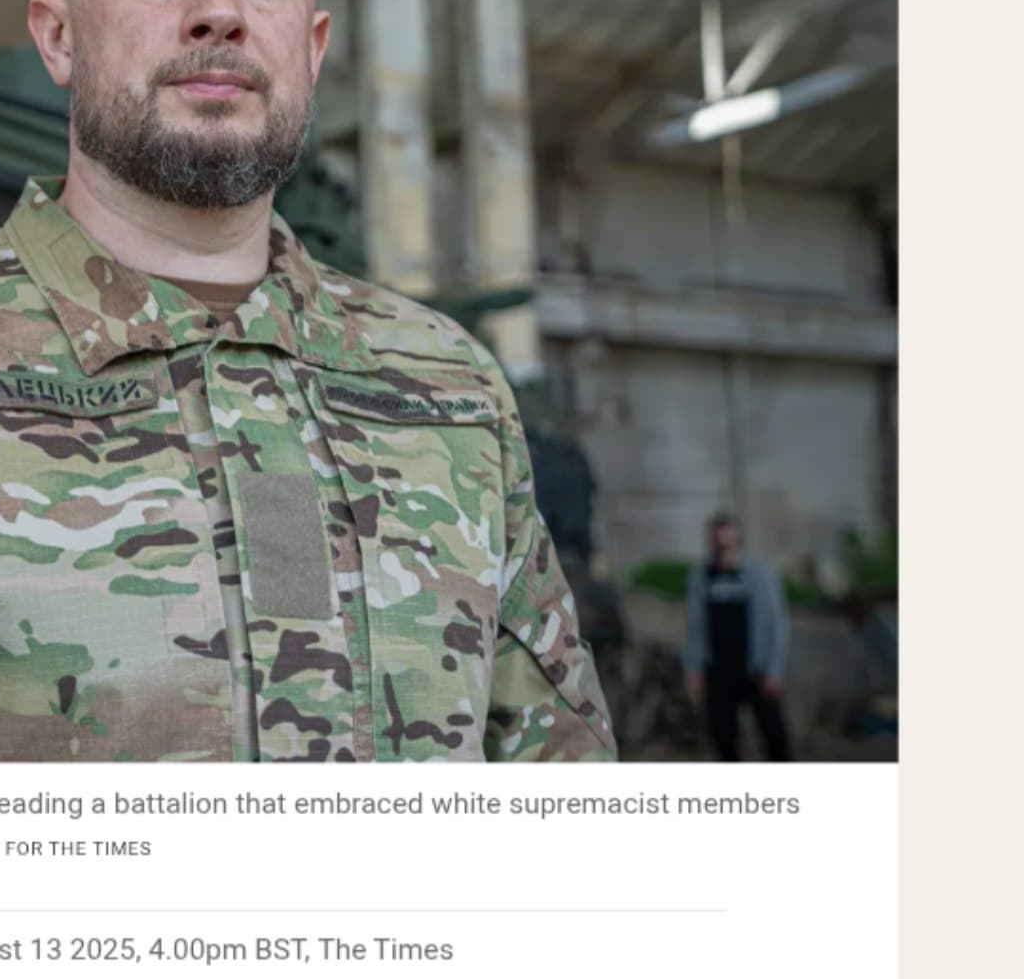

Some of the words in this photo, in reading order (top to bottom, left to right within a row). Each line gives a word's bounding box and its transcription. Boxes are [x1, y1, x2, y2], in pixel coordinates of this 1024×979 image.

[92, 798, 105, 814] a
[115, 792, 226, 814] battalion
[235, 792, 285, 814] that
[295, 792, 422, 814] embraced
[432, 792, 501, 814] white
[510, 792, 669, 819] supremacist
[678, 792, 799, 814] members
[6, 841, 42, 856] FOR
[49, 841, 85, 856] THE
[93, 841, 151, 856] TIMES
[32, 938, 61, 960] 13
[71, 938, 141, 964] 2025,
[149, 938, 246, 965] 4.00pm
[256, 938, 310, 964] BST,
[318, 938, 366, 960] The
[373, 938, 453, 960] Times
